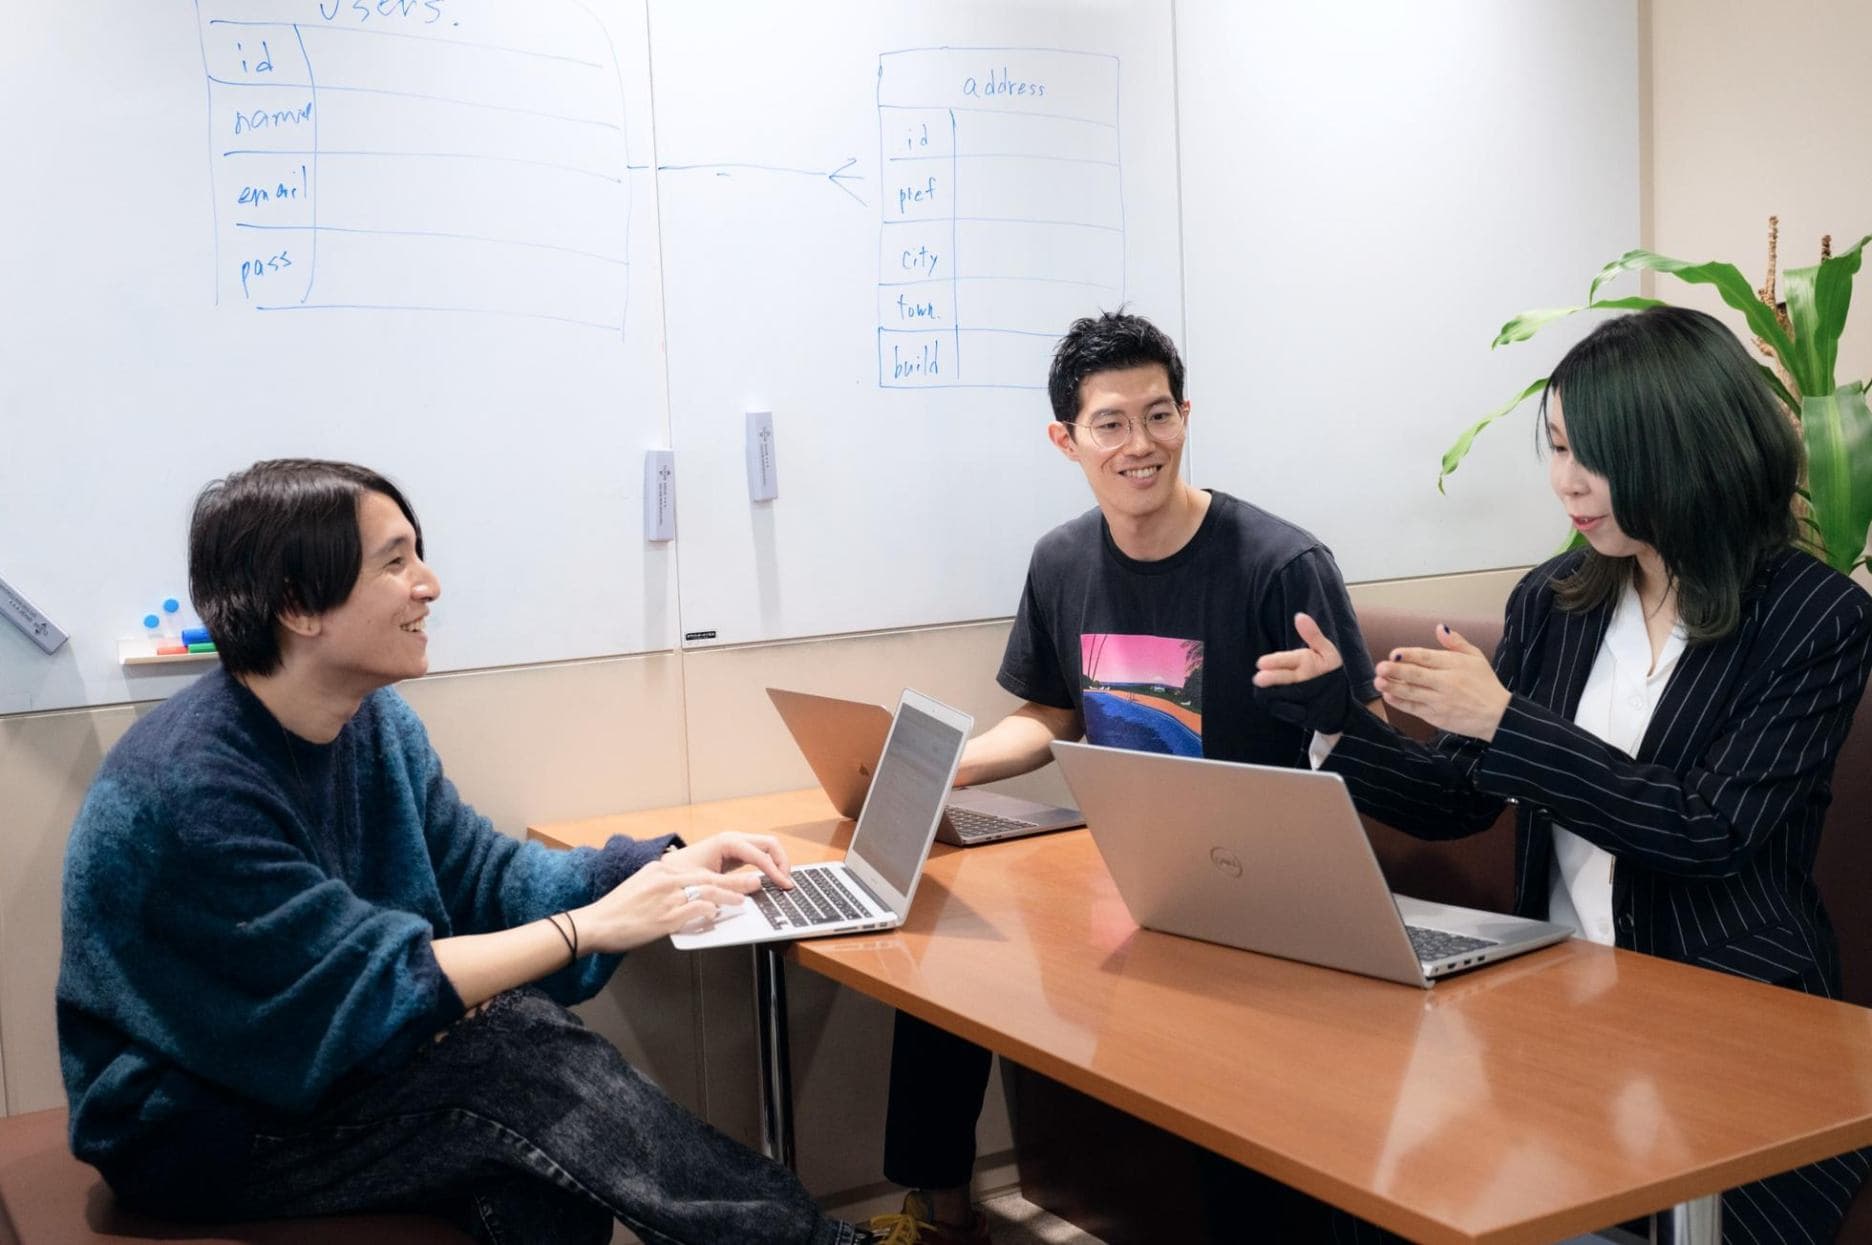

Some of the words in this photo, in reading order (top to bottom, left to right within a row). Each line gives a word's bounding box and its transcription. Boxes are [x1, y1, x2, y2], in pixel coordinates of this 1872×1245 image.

[237, 41, 273, 73] id
[963, 66, 1046, 98] address
[908, 123, 928, 150] id
[238, 165, 307, 207] email
[899, 176, 936, 214] pref
[241, 251, 292, 299] pass
[894, 339, 939, 379] build
